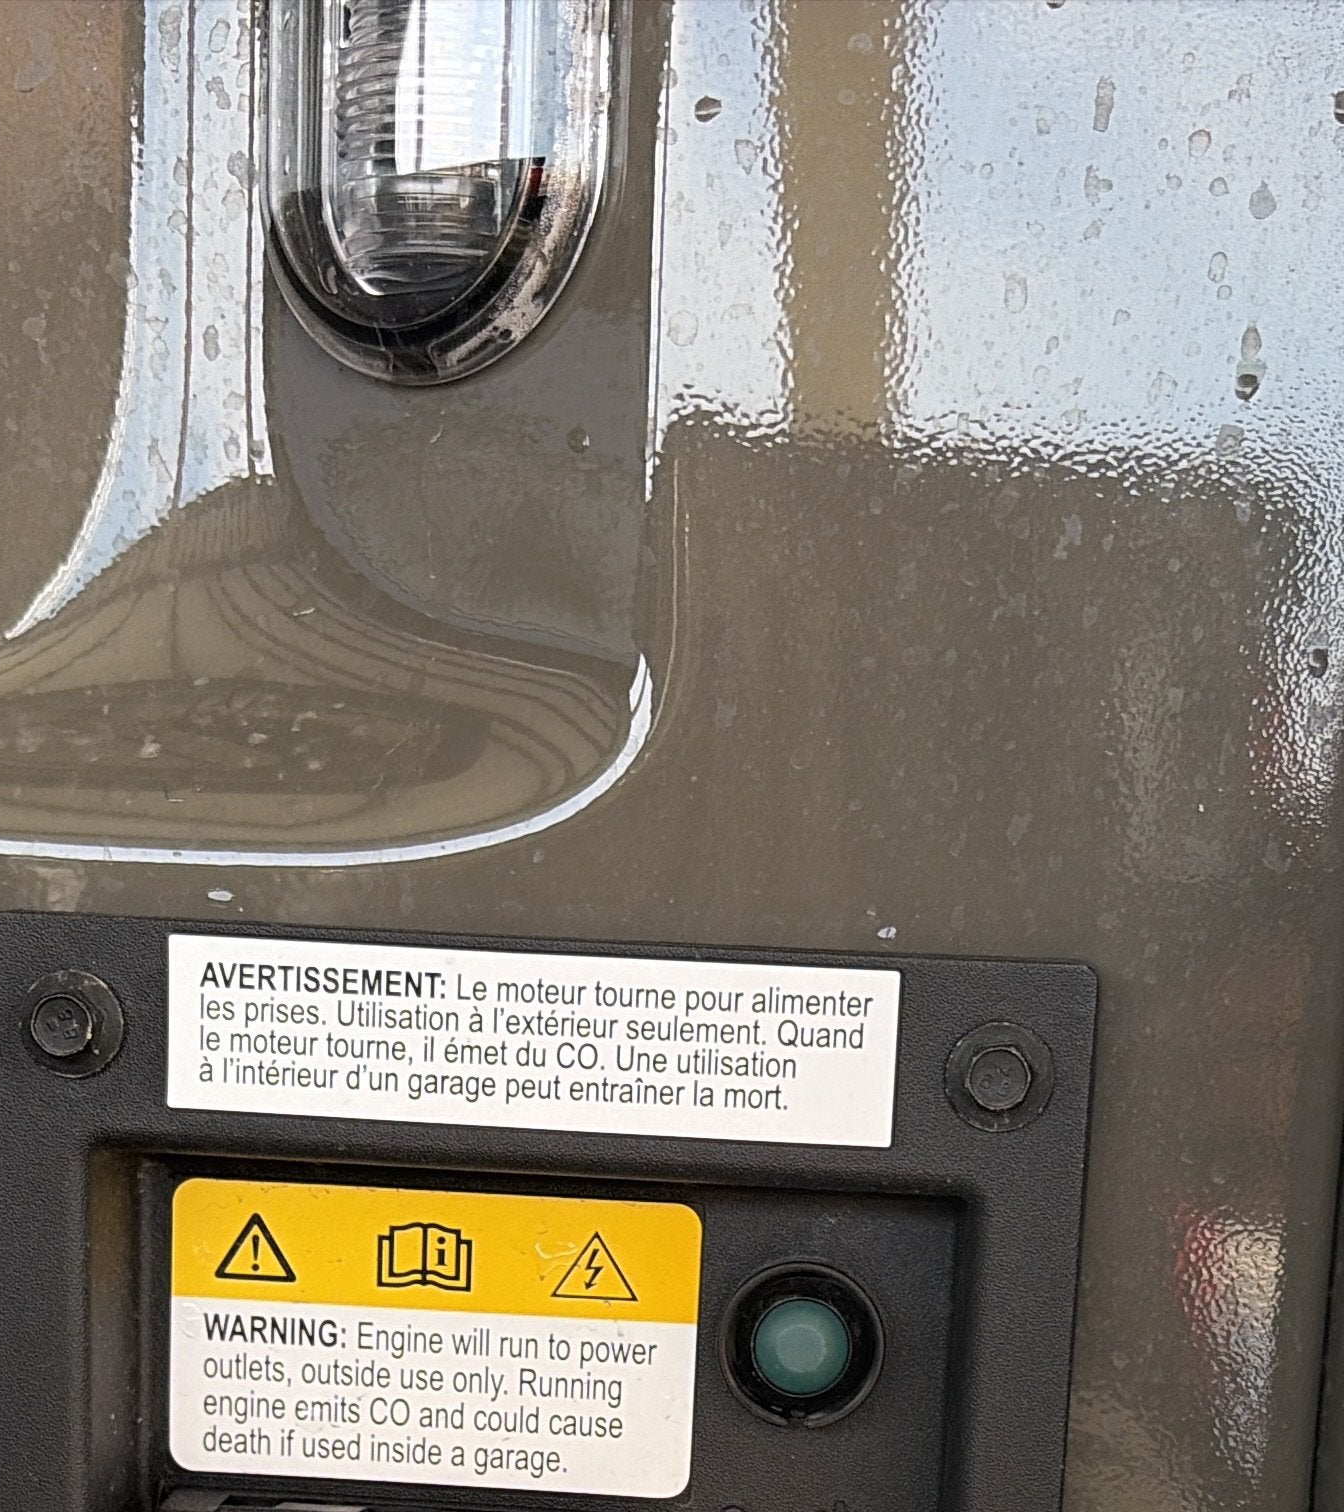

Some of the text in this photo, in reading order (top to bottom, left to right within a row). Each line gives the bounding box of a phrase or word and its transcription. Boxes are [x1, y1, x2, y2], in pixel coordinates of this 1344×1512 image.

[200, 962, 873, 1017] AVERTISSEMENT: Le moteur tourne pour alimenter
[201, 994, 864, 1049] les prises. Utilisation à l’extérieur seulement. Quand
[201, 1025, 796, 1078] le moteur tourne, il émet du CO. Une utilisation
[200, 1056, 787, 1110] à l’intérieur d’un garage peut entraîner la mort.
[204, 1313, 657, 1369] WARNING: Engine will run to power
[204, 1353, 621, 1408] outlets, outside use only. Running
[204, 1390, 622, 1438] engine emits CO and could cause
[203, 1425, 566, 1478] death if used inside a garage.
